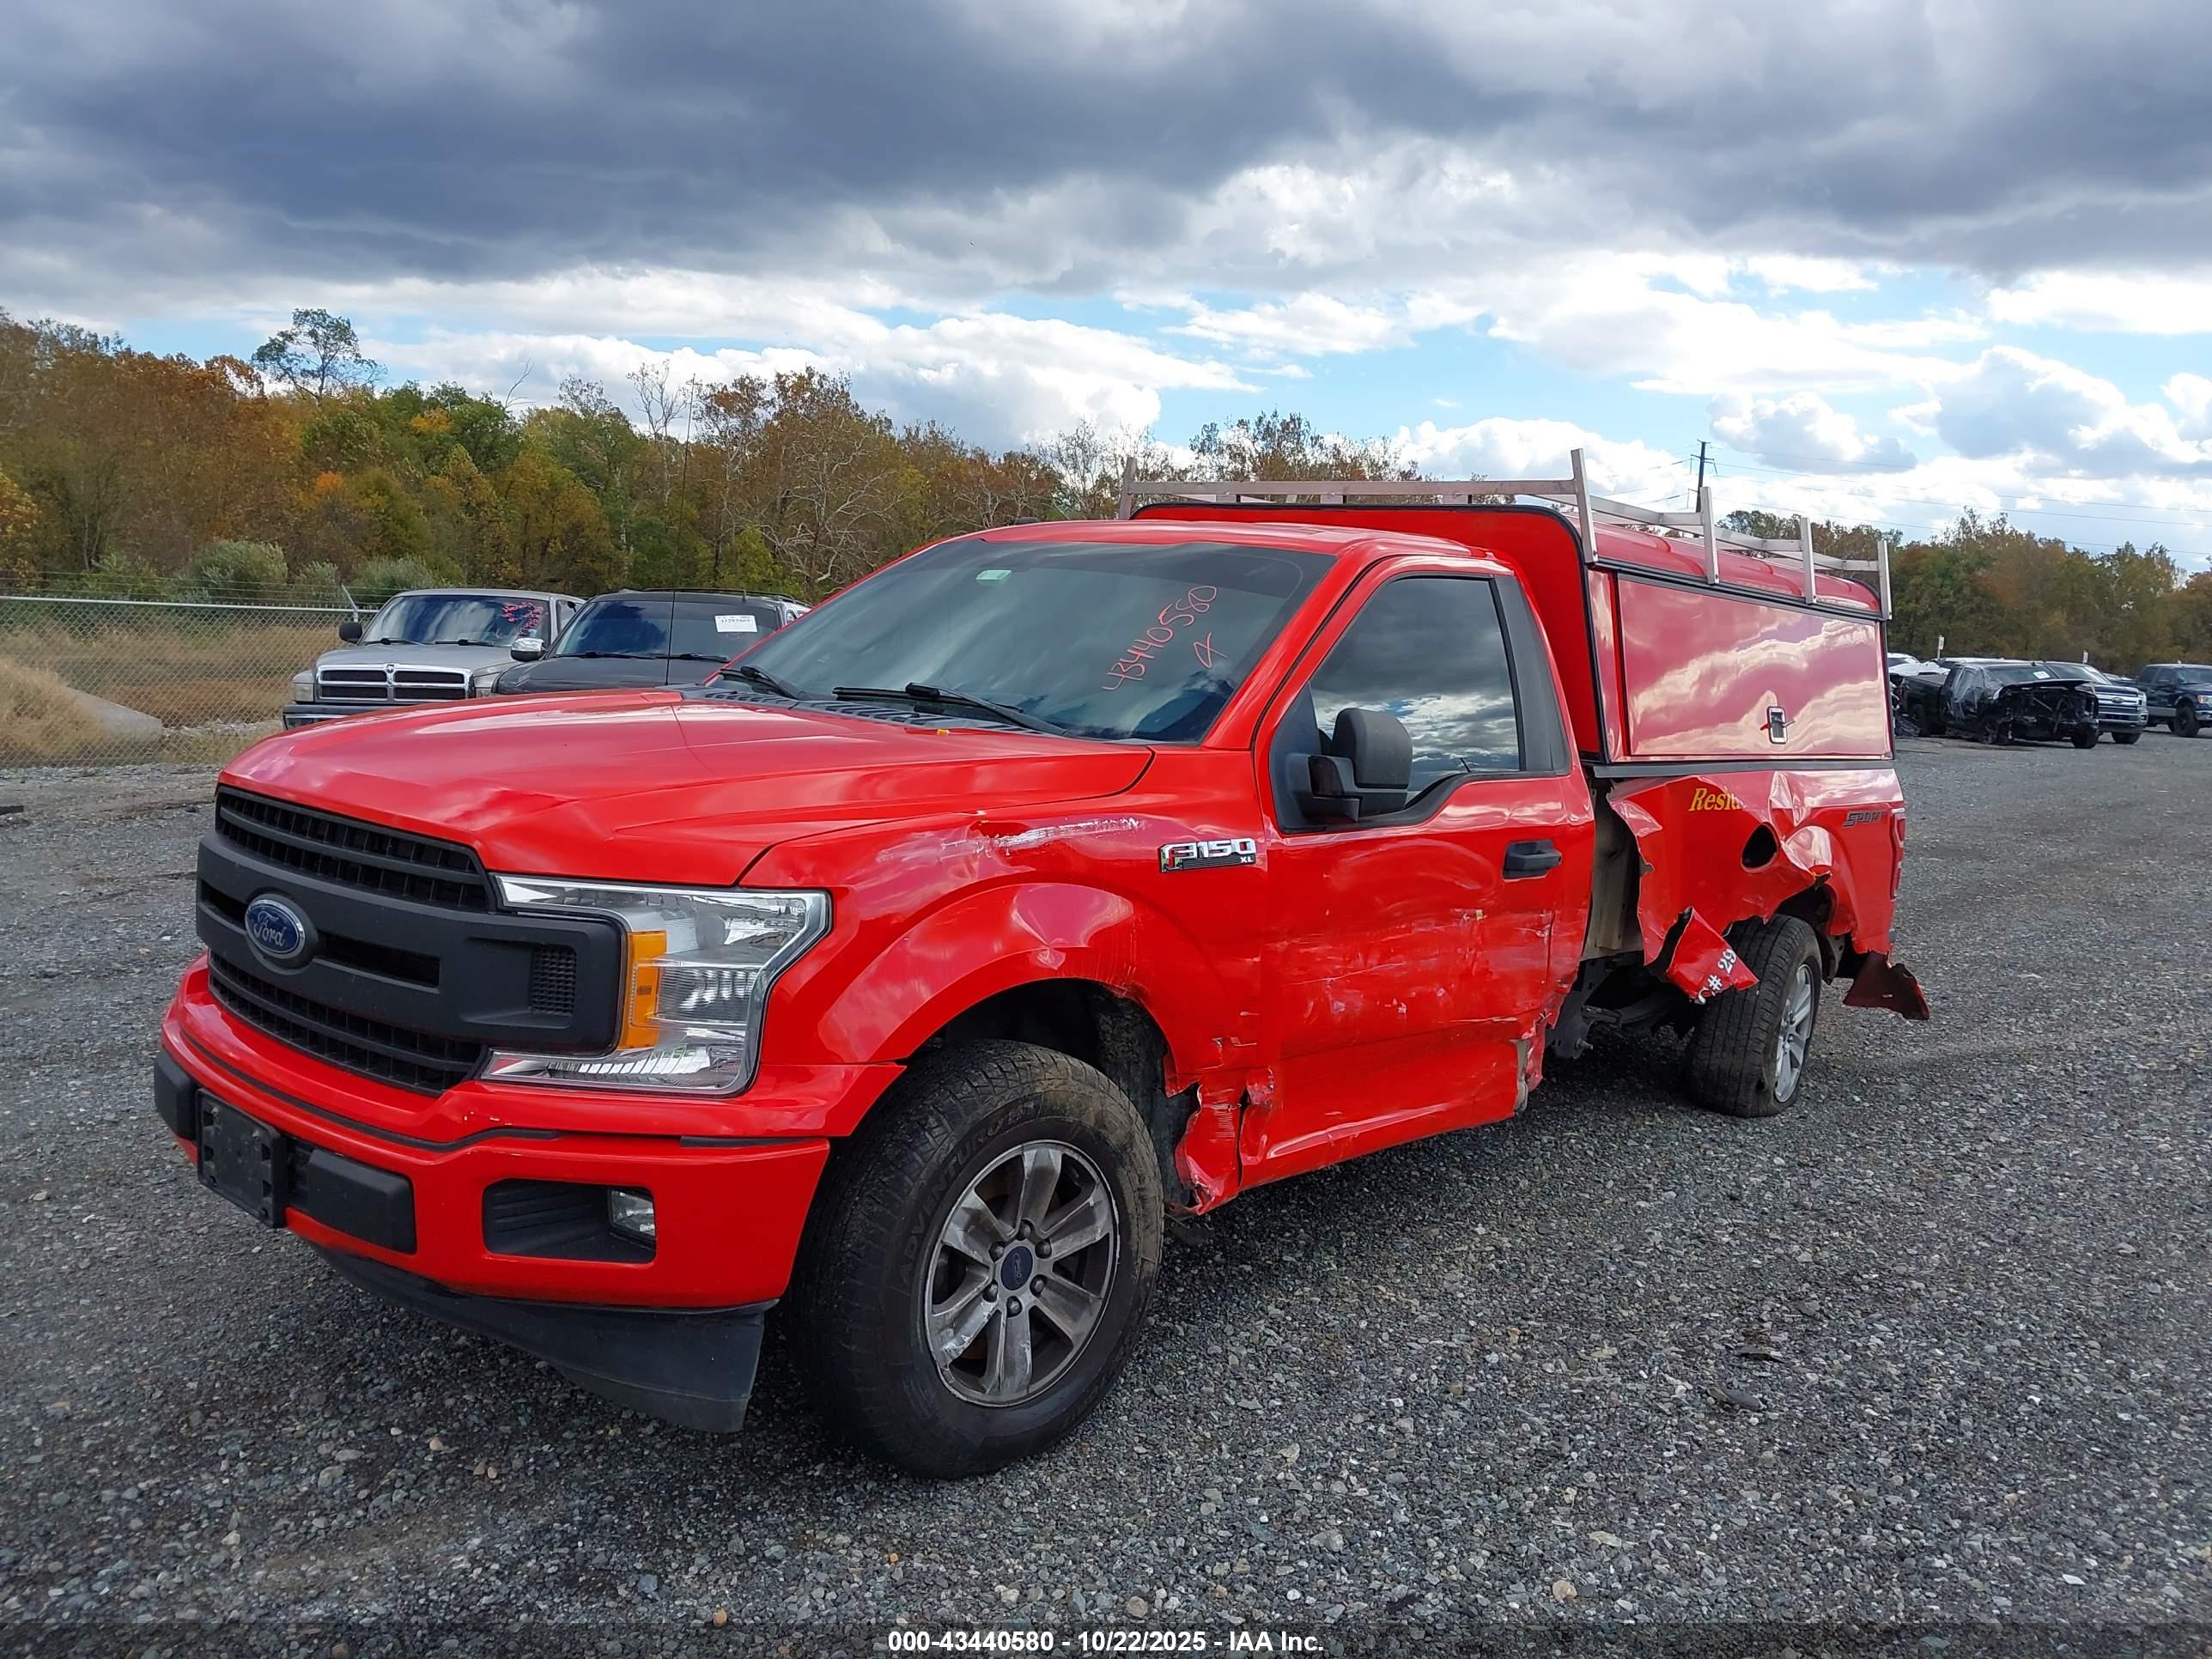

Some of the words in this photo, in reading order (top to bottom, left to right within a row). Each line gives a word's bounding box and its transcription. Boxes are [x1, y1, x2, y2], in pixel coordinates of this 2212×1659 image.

[1842, 811, 1883, 829] SPORT
[253, 910, 288, 947] Ford
[1717, 948, 1736, 975] 29
